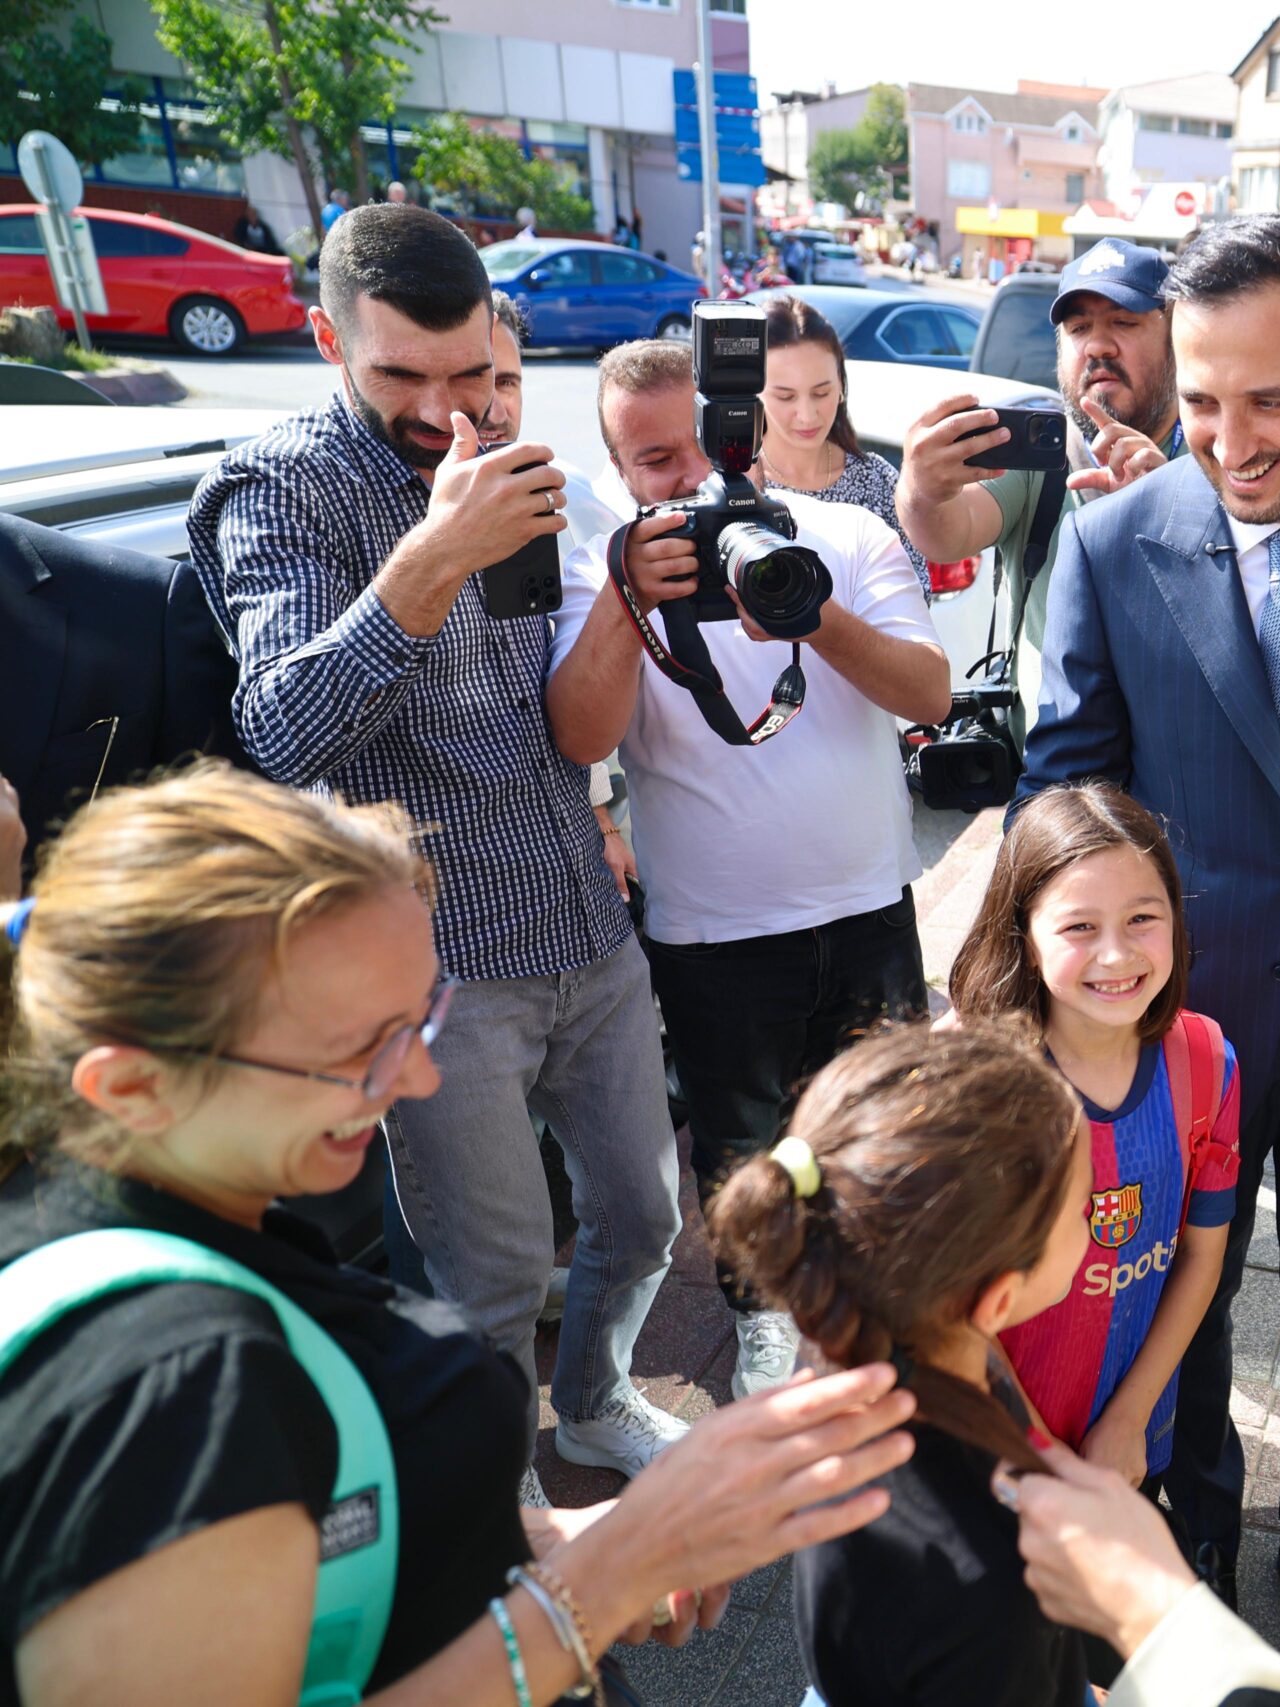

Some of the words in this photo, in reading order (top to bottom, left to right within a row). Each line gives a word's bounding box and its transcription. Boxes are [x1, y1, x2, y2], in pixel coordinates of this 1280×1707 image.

[728, 498, 756, 507] Canon
[623, 584, 665, 661] Canon
[1082, 1228, 1178, 1298] Spot
